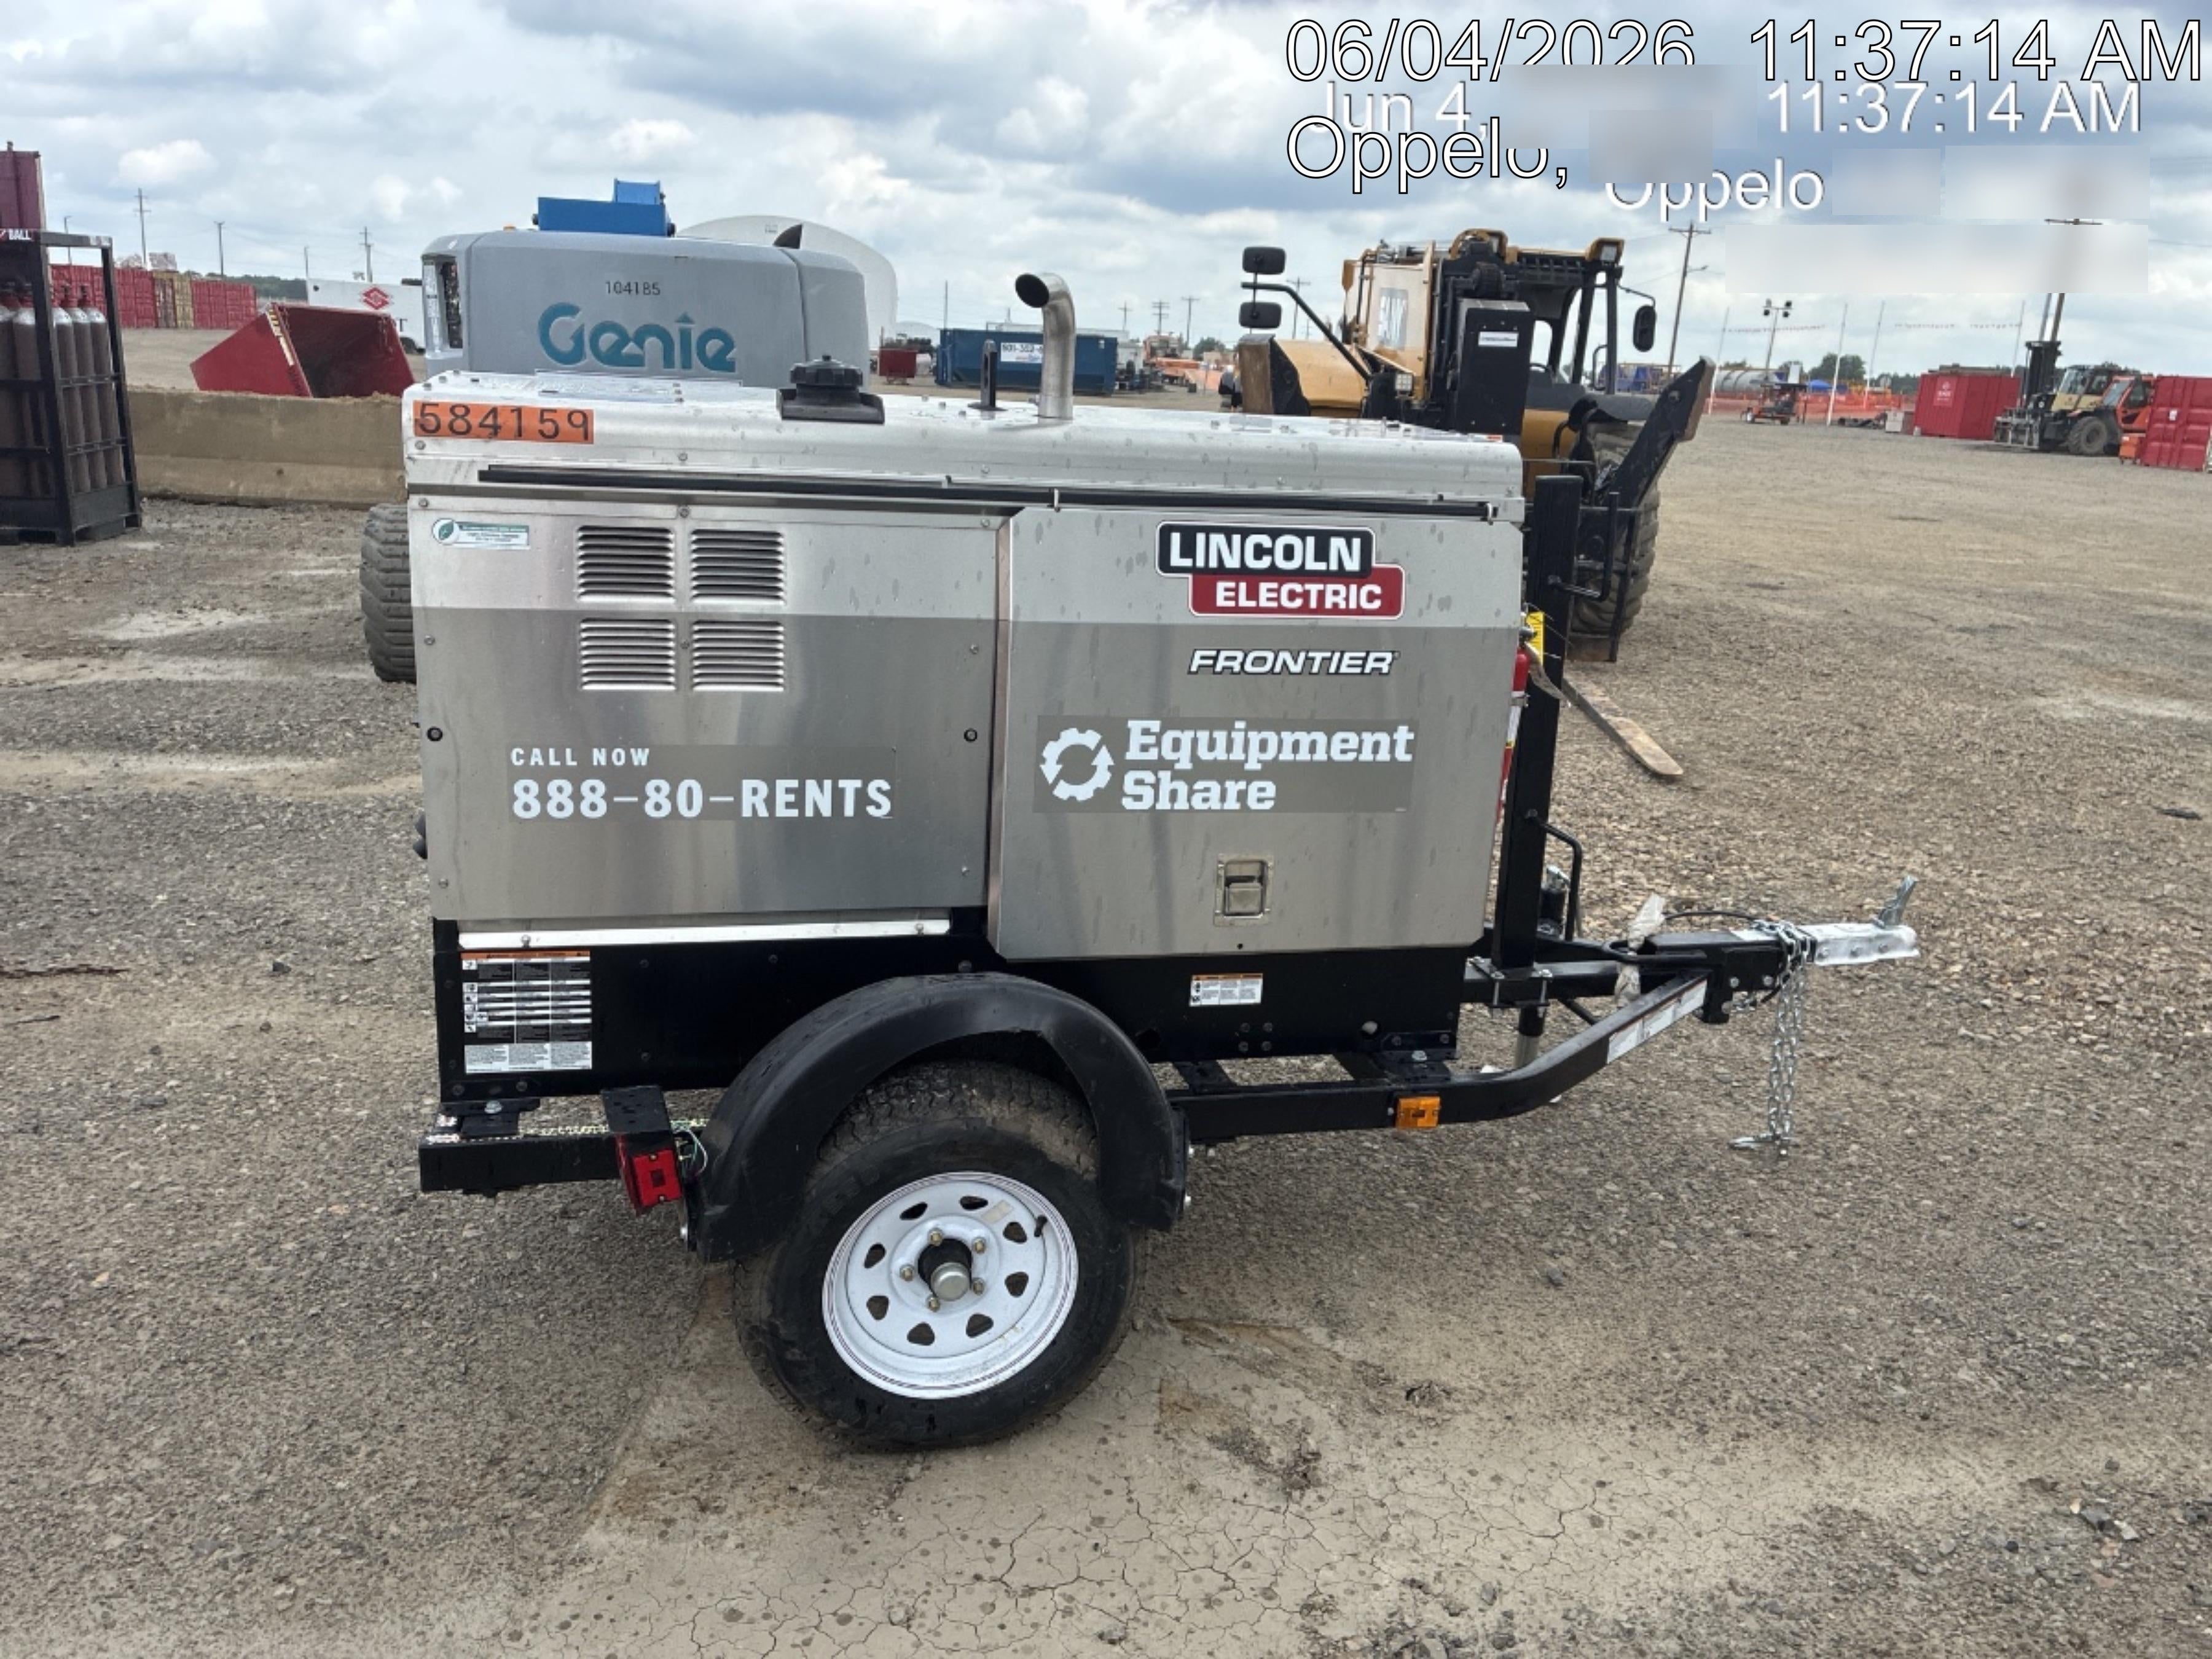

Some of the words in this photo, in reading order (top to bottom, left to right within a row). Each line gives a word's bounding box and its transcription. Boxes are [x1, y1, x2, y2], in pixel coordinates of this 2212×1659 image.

[538, 302, 736, 372] Genie
[418, 402, 590, 441] 584159
[1170, 532, 1362, 571] LINCOLN
[1215, 581, 1382, 610] ELECTRIC
[1188, 649, 1396, 675] FRONTIER
[511, 747, 578, 766] CALL
[592, 747, 651, 766] NOW
[1125, 720, 1414, 770] Equipment
[512, 778, 893, 819] 888-80-RENTS
[1122, 770, 1276, 810] Share
